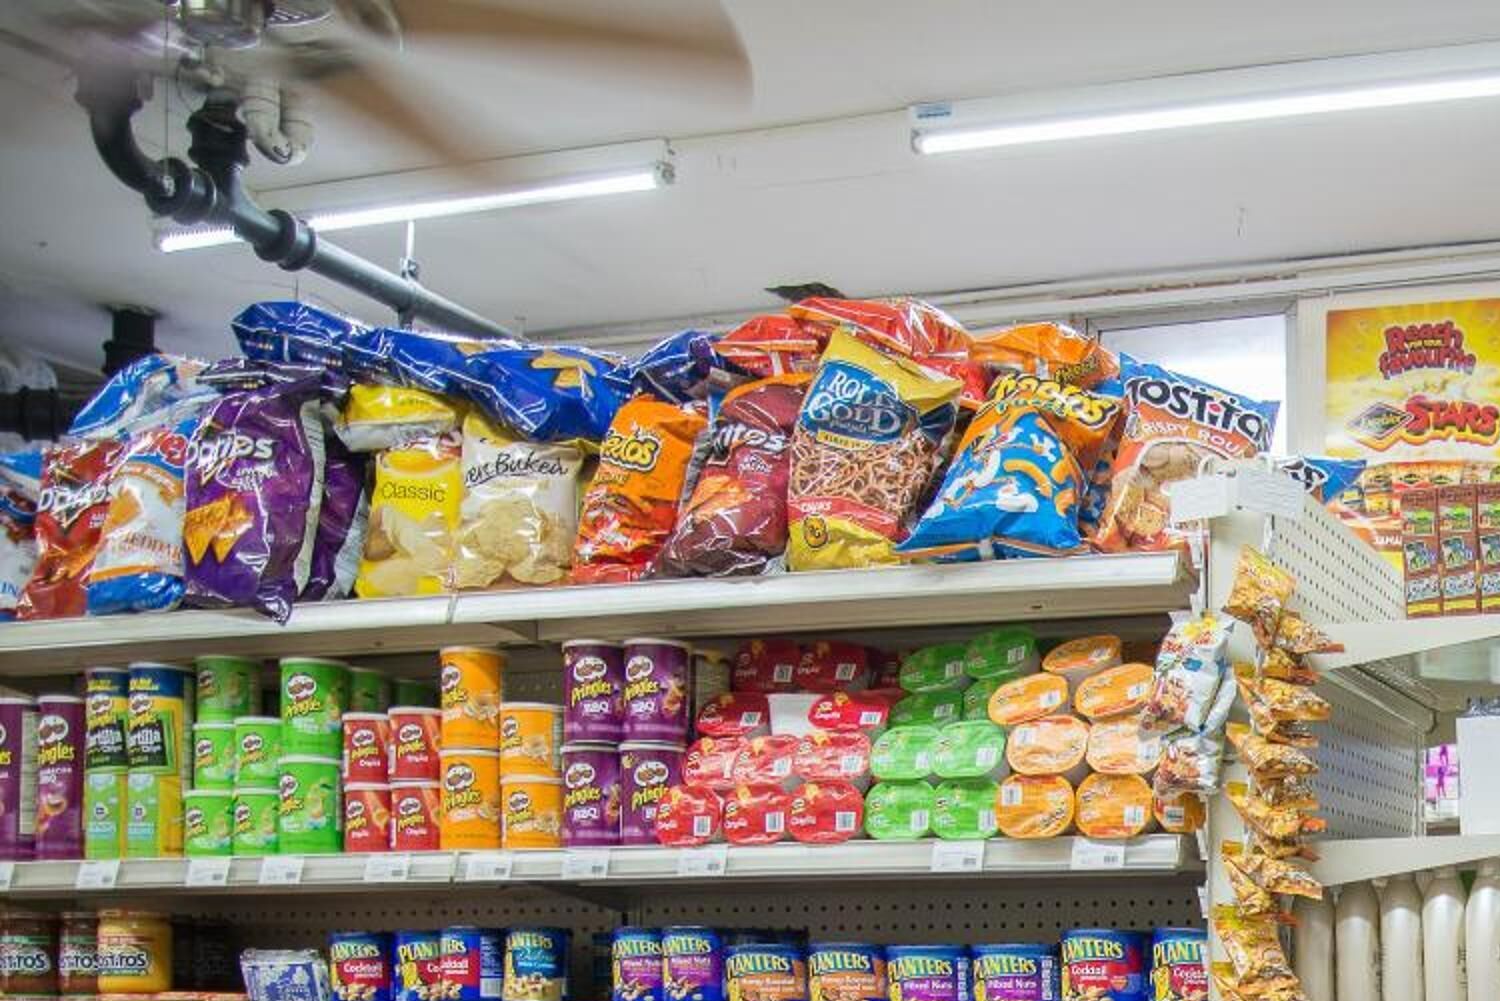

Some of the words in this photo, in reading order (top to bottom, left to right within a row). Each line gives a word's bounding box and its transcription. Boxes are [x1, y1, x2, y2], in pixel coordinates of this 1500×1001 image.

[812, 394, 901, 436] GOLD
[1405, 399, 1500, 435] STARS
[380, 481, 446, 504] Classic
